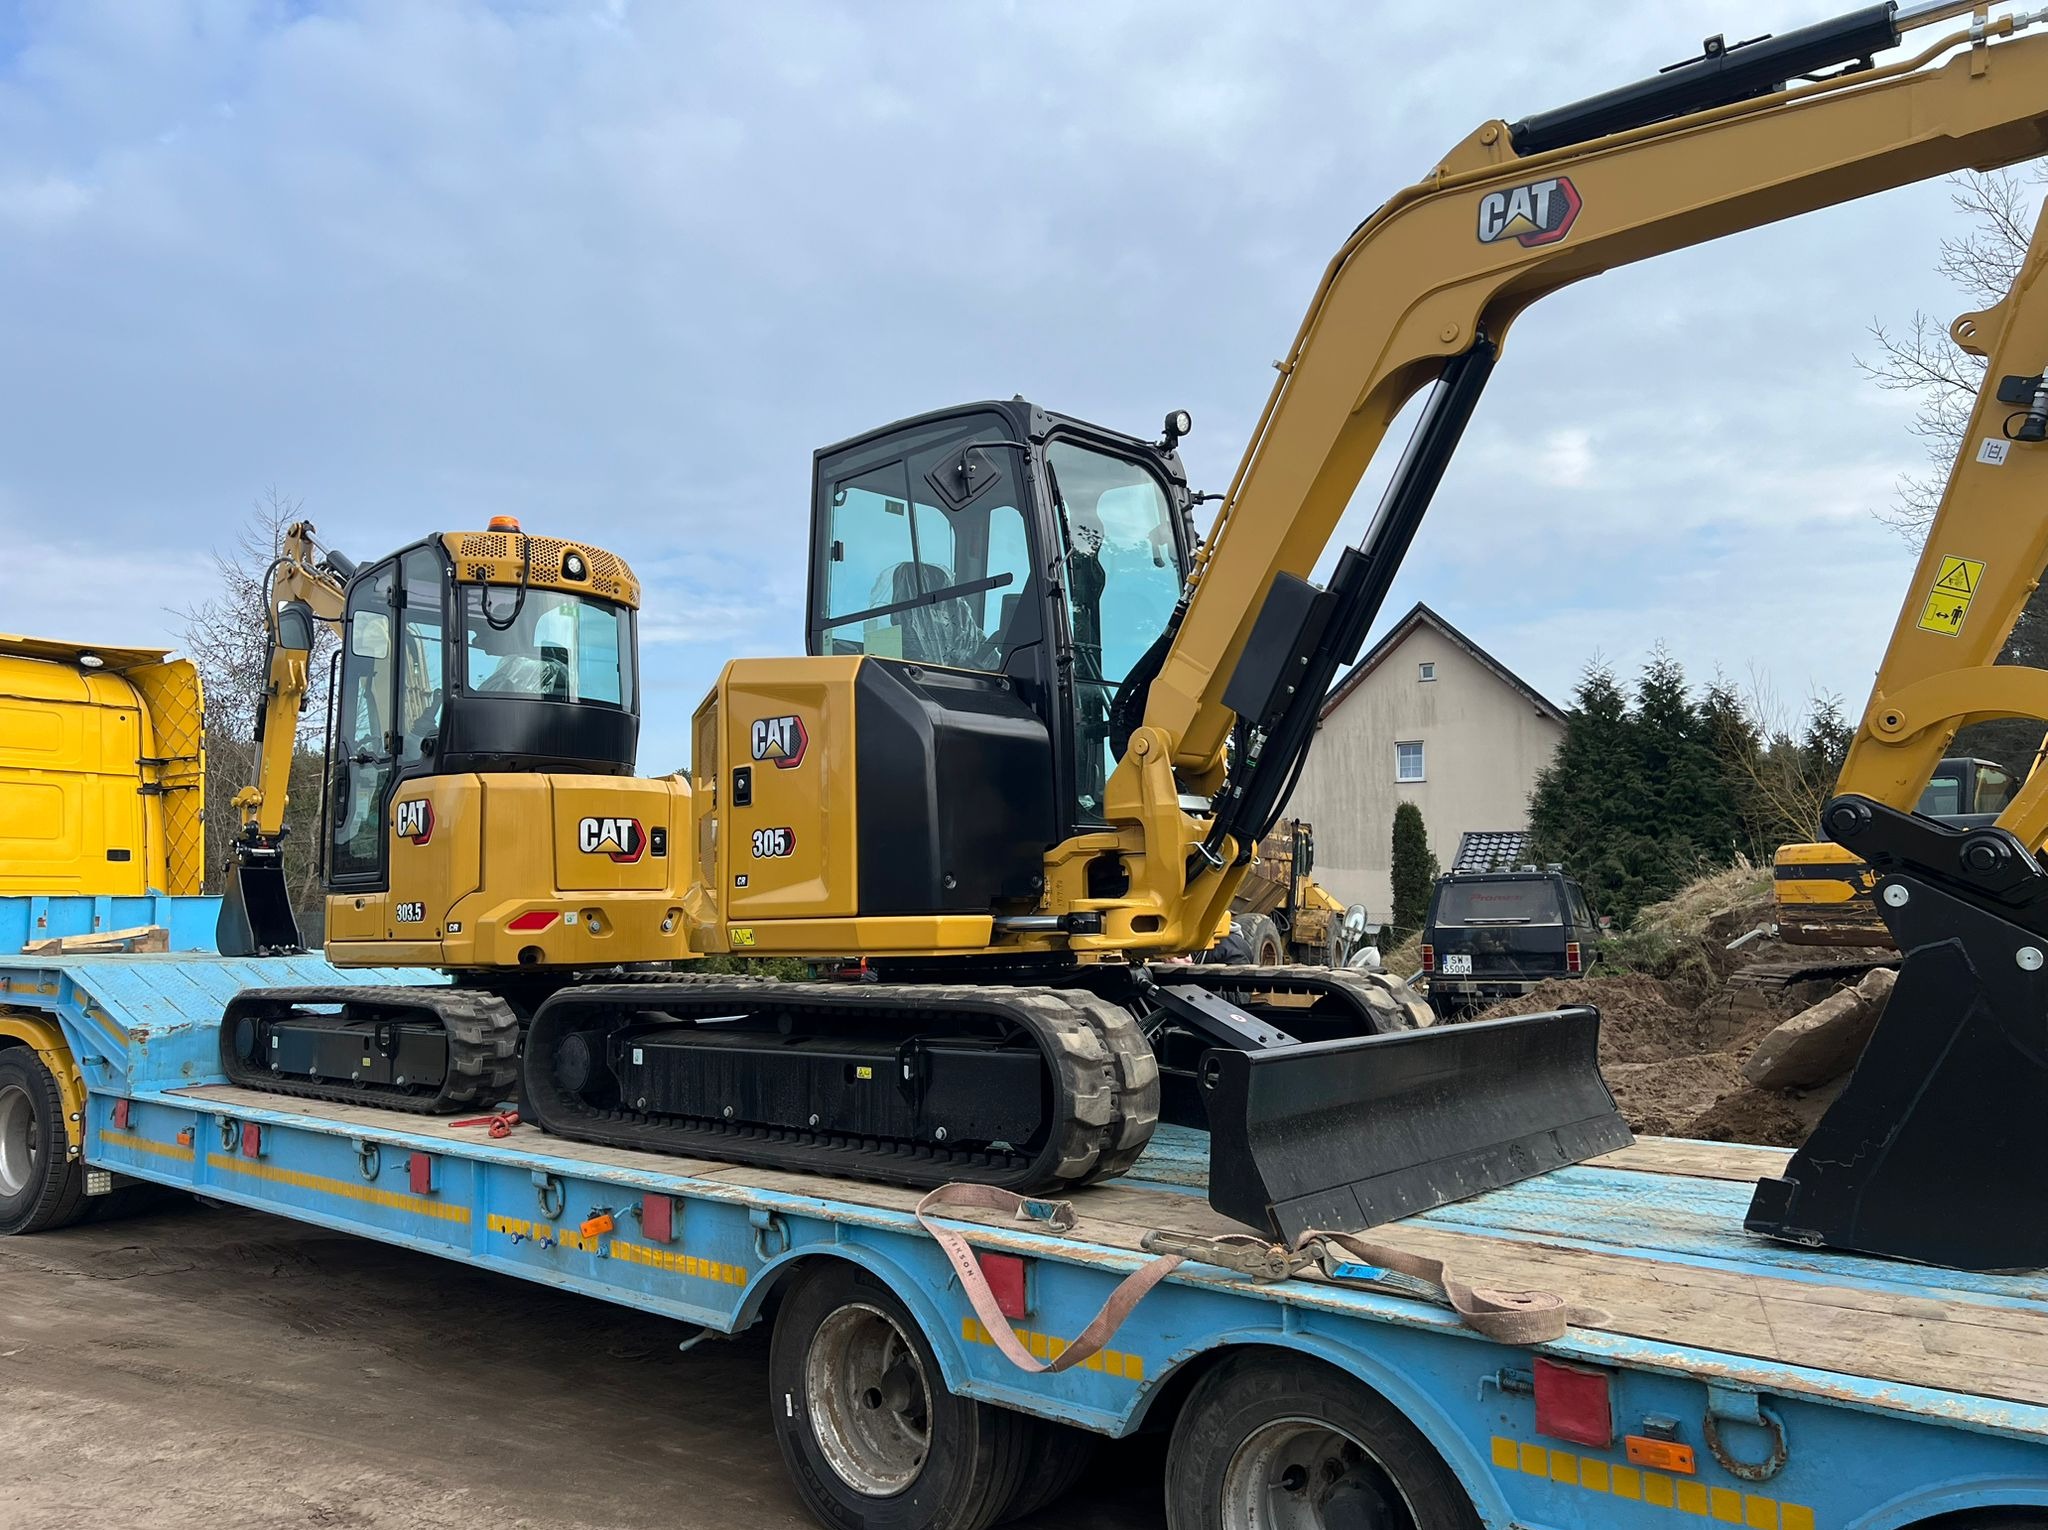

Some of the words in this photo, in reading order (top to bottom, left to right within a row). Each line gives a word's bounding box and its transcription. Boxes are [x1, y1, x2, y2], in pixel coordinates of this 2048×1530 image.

[1480, 179, 1557, 242] CAT
[751, 717, 794, 760] CAT
[397, 800, 426, 837] CAT
[580, 818, 632, 852] CAT
[752, 829, 785, 857] 305
[396, 902, 422, 921] 303.5
[448, 923, 459, 932] CR
[1443, 965, 1471, 974] 55004
[1451, 955, 1463, 965] SW
